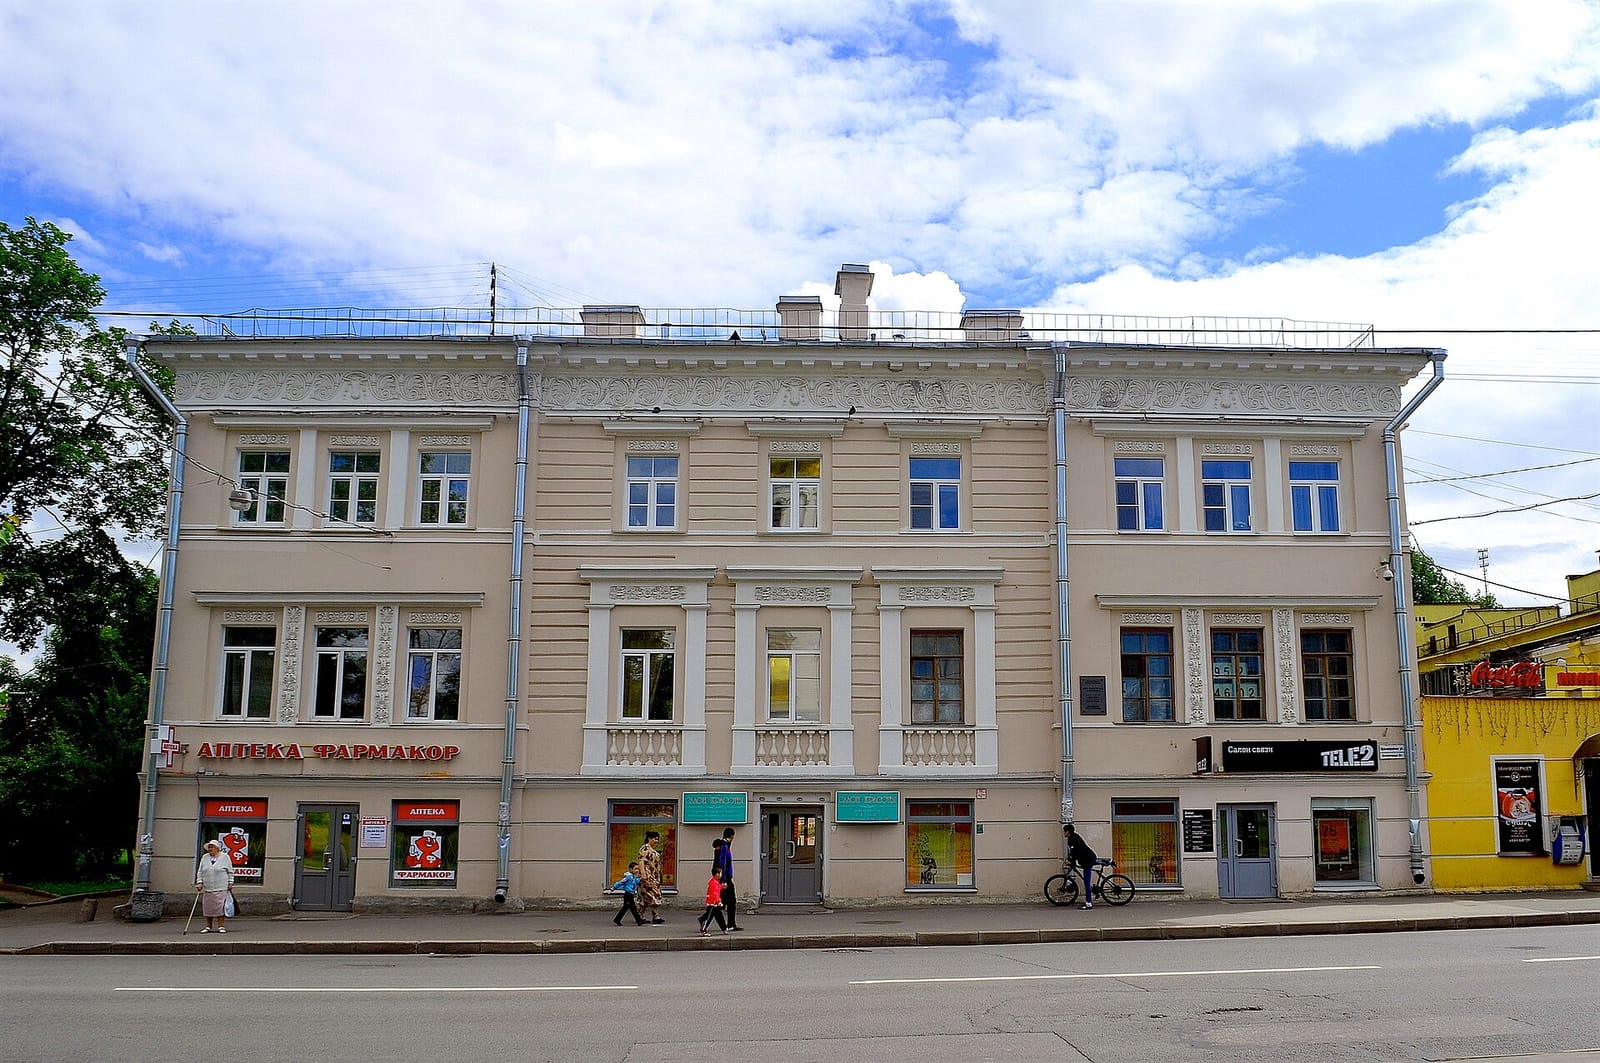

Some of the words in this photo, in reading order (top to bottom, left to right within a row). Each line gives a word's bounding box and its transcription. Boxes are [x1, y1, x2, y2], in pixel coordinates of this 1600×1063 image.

[197, 742, 304, 760] АПТЕКА
[312, 743, 461, 761] ФАРМАКОР
[1320, 745, 1375, 767] TELE2
